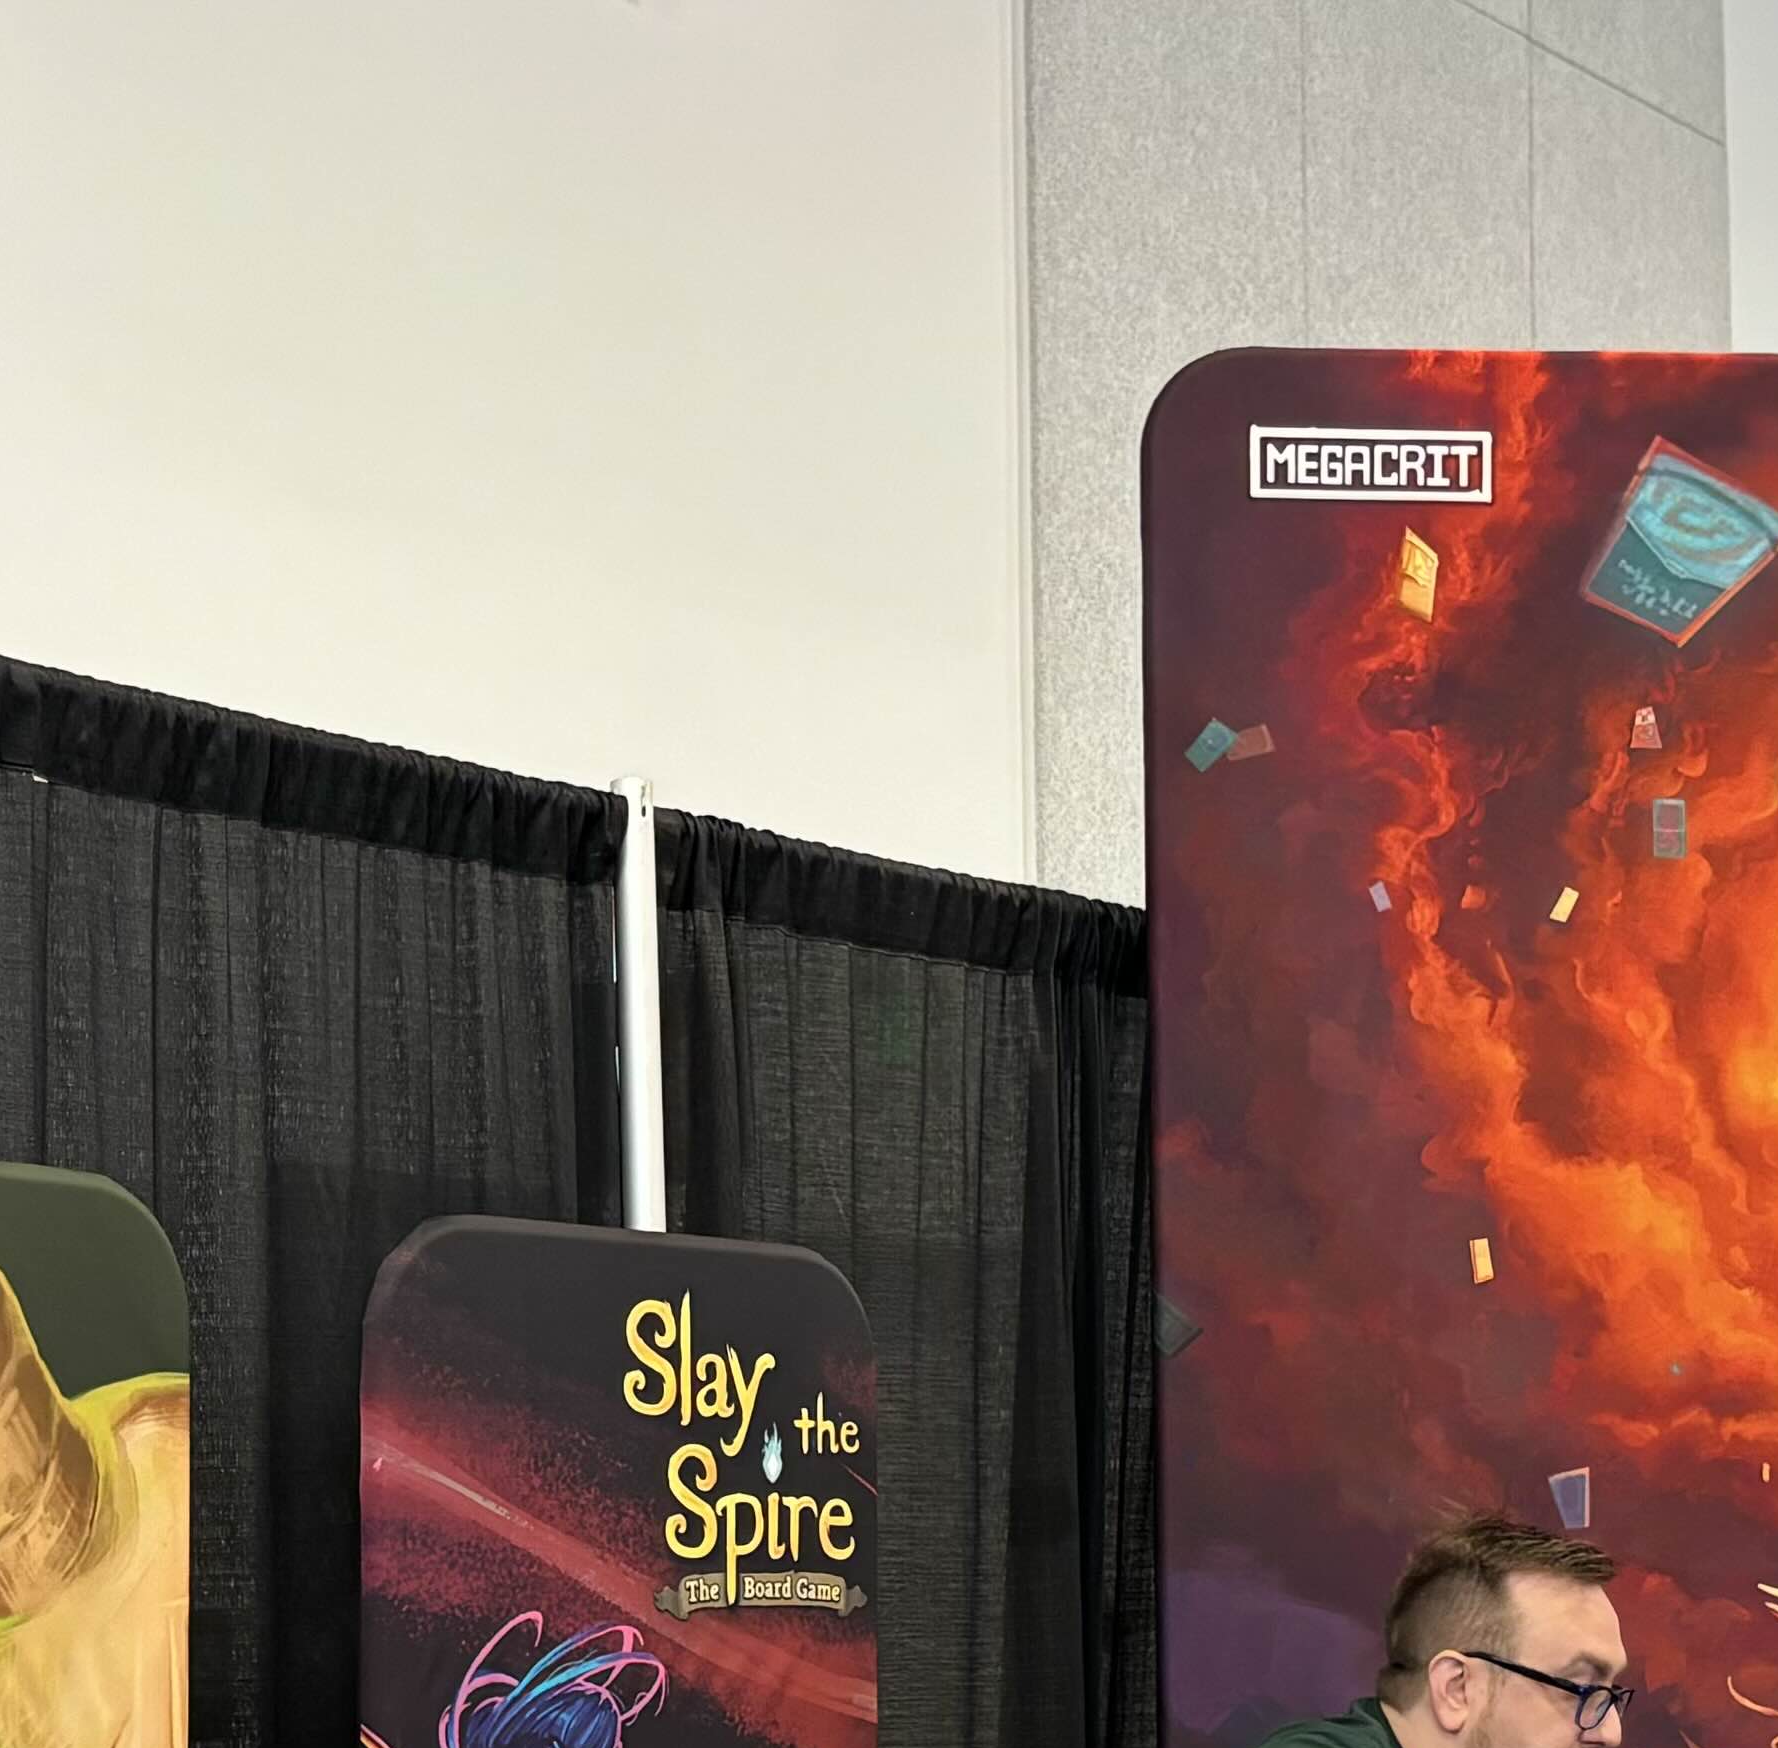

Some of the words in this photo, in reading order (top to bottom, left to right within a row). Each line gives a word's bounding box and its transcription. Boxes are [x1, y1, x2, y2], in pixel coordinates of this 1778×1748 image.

[1263, 441, 1480, 490] MEGACRIT
[624, 1287, 776, 1457] Slay
[793, 1392, 860, 1455] the
[665, 1443, 855, 1606] Spire
[685, 1579, 720, 1604] The
[743, 1575, 792, 1600] Board
[795, 1579, 841, 1602] Game
